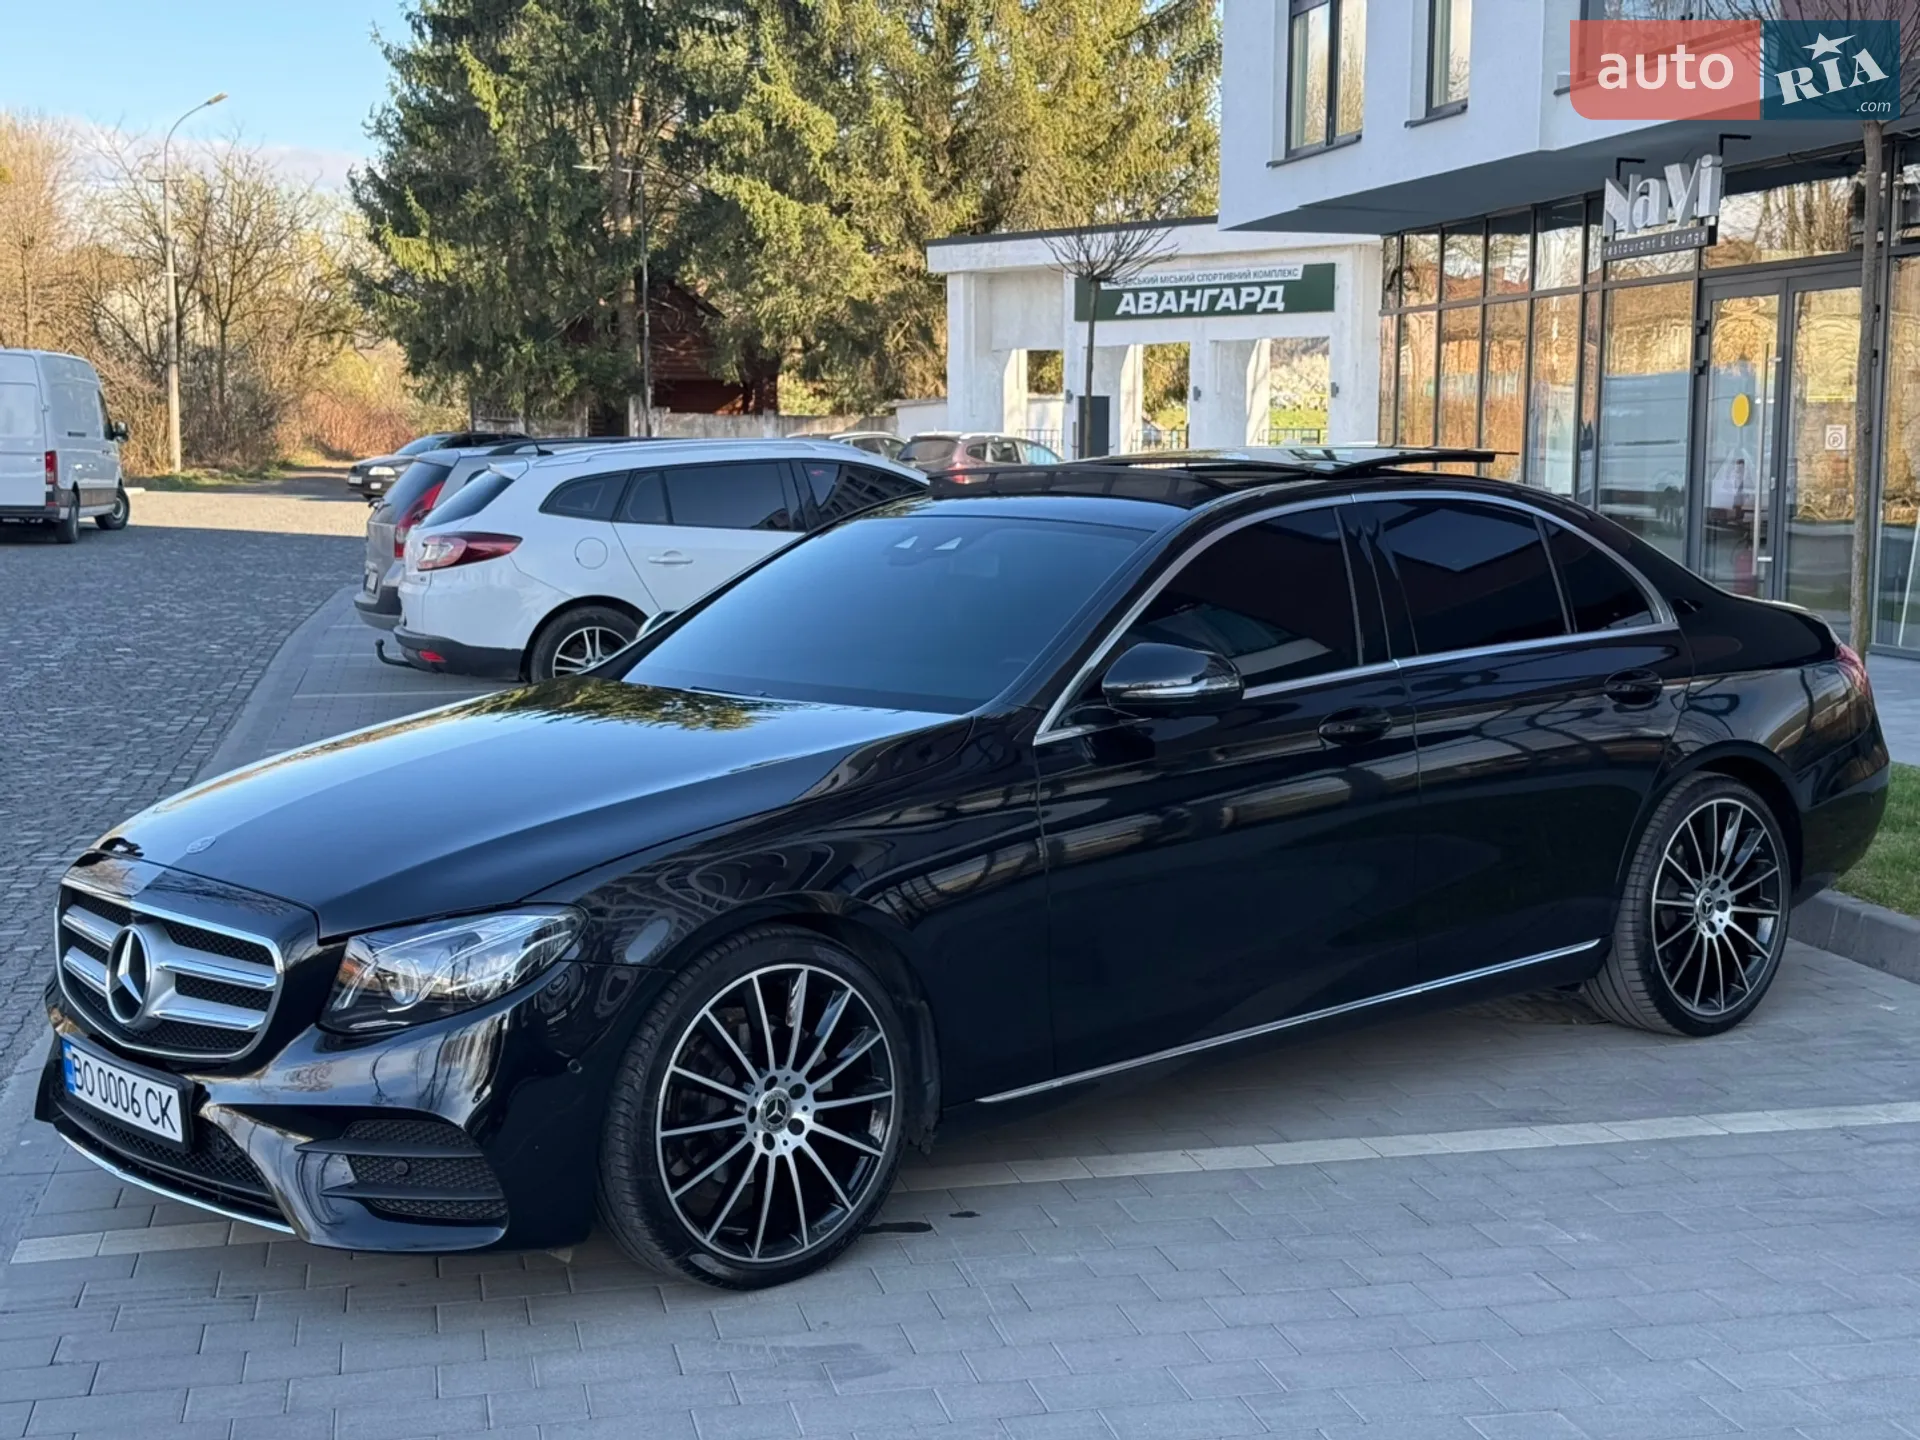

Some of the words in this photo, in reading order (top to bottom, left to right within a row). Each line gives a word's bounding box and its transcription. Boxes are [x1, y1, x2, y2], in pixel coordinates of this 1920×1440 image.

[1603, 239, 1656, 257] restaurant
[1670, 232, 1706, 246] lounge
[1160, 271, 1195, 284] МІСЬКИЙ
[1196, 269, 1252, 283] СПОРТИВНИЙ
[1252, 267, 1299, 280] КОМПЛЕКС
[1115, 285, 1285, 315] АВАНГАРД
[72, 1053, 95, 1097] BO
[98, 1067, 141, 1118] 0006
[145, 1087, 177, 1133] CK
